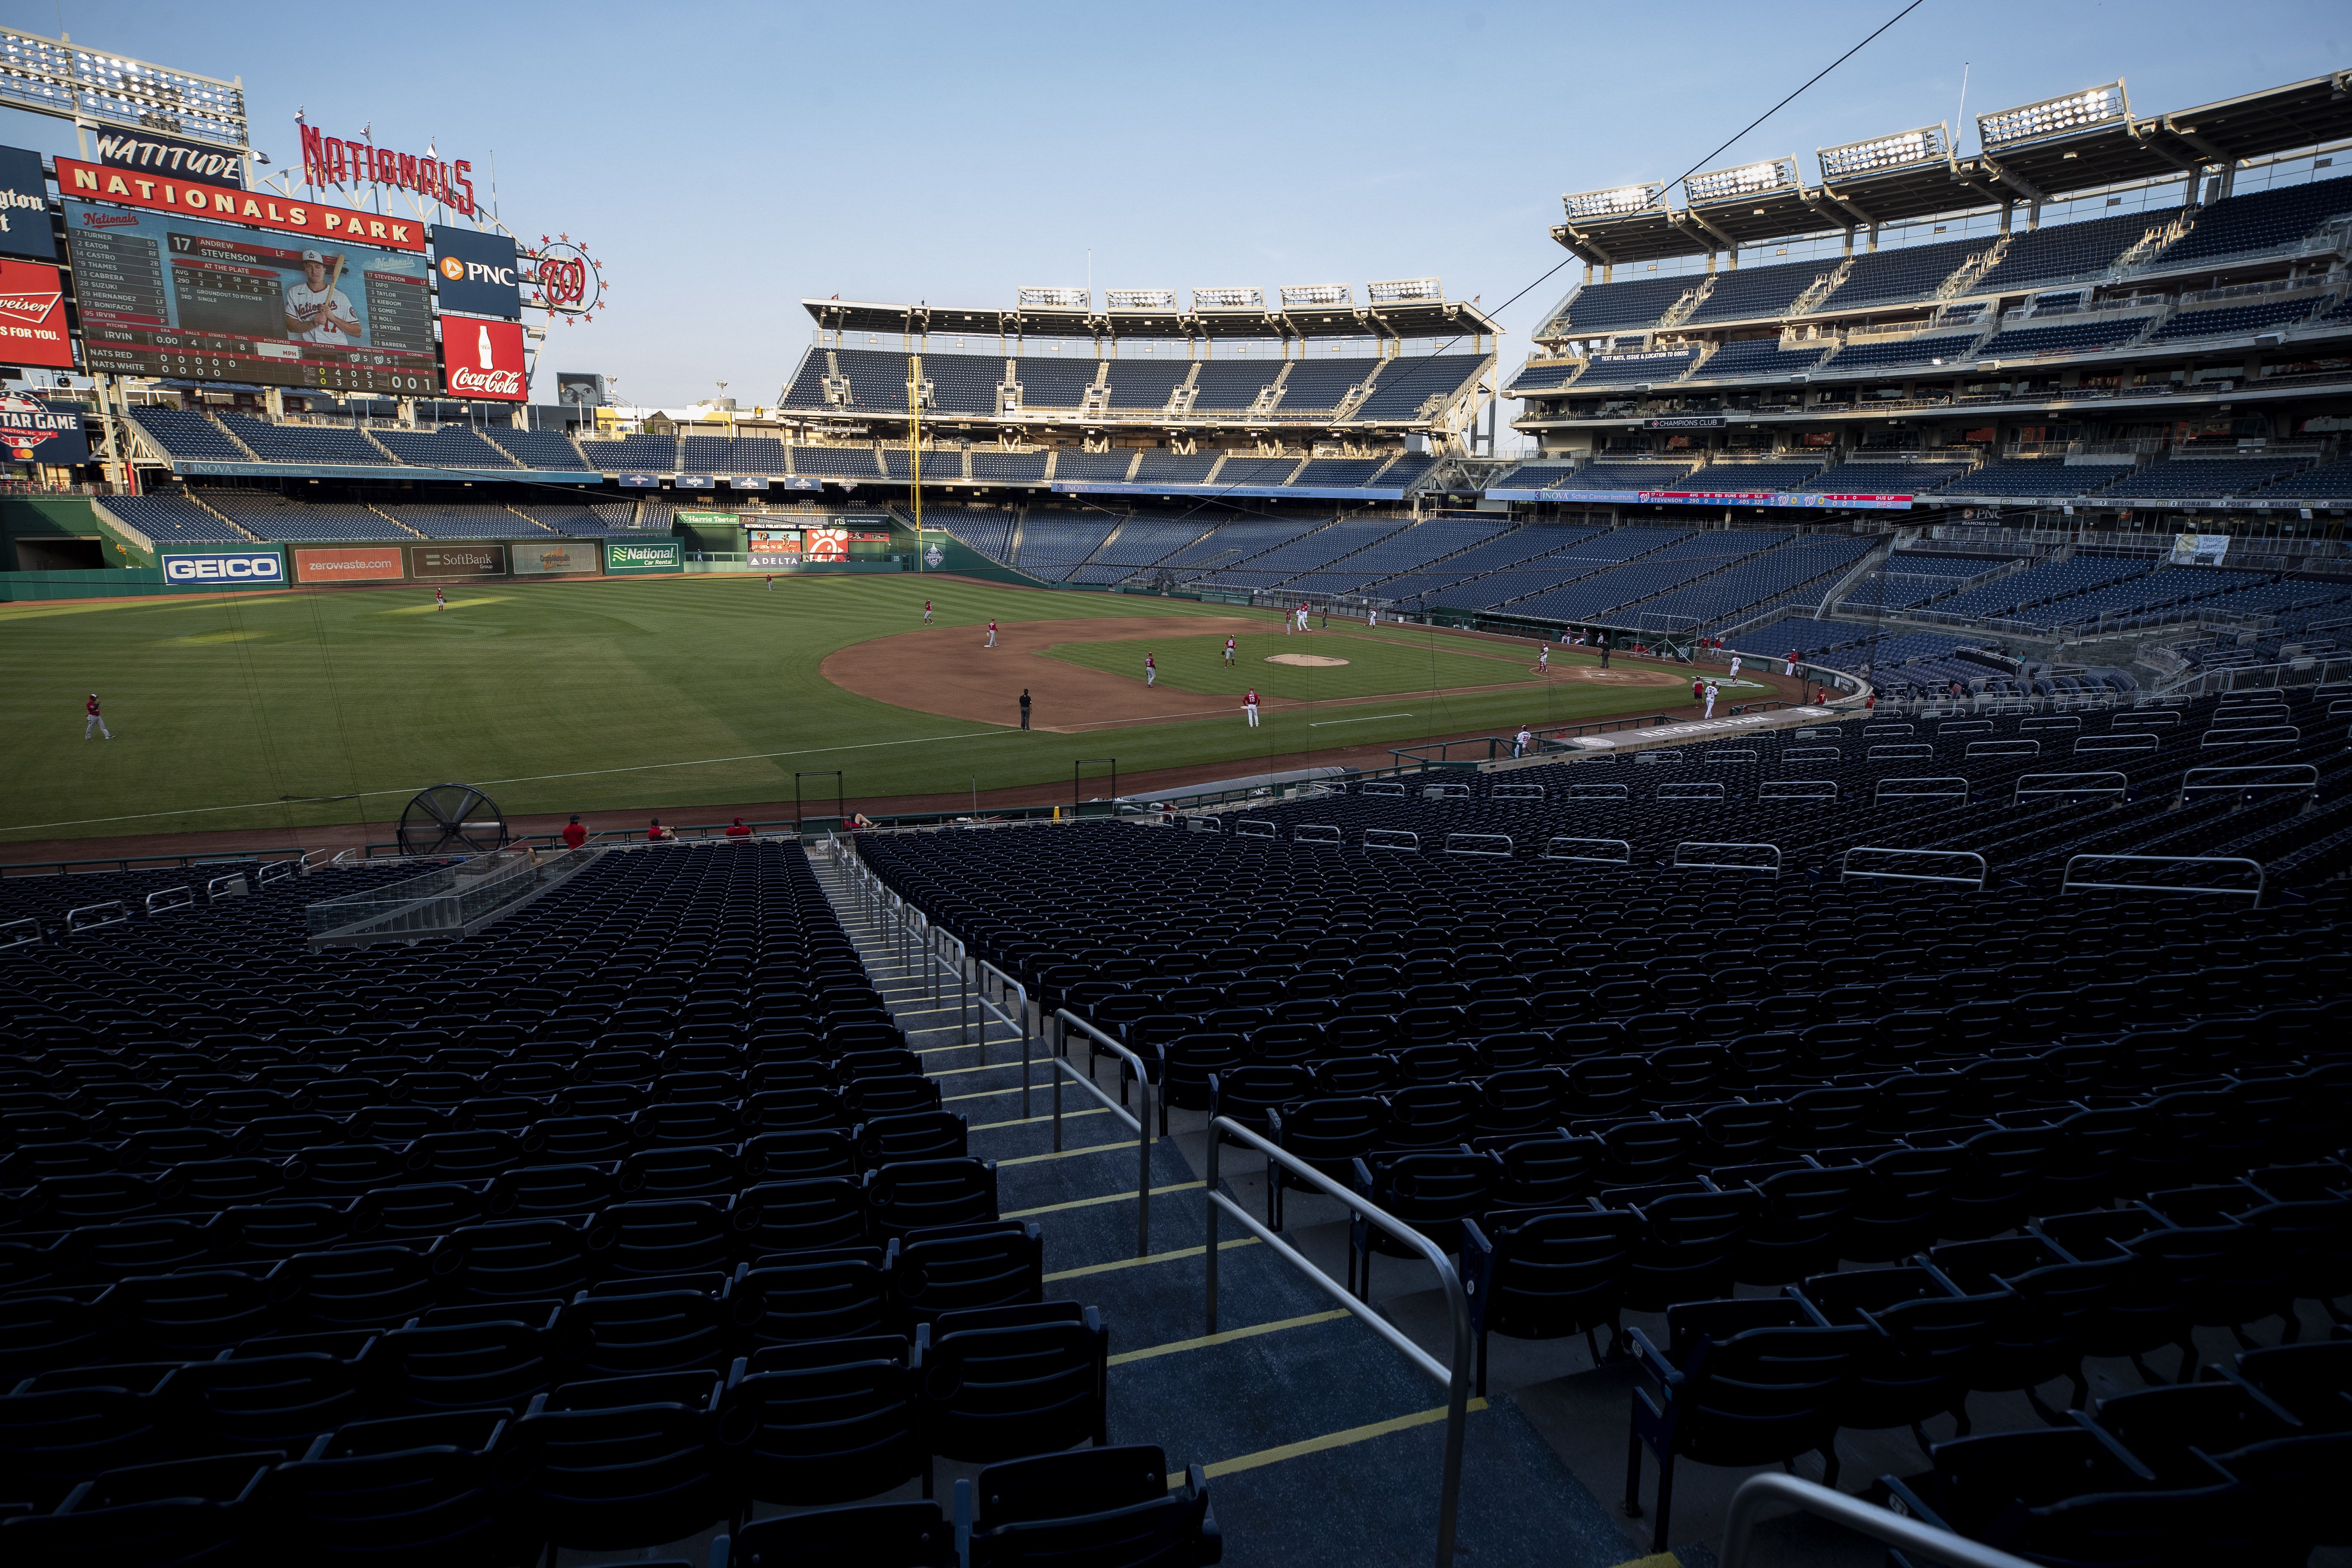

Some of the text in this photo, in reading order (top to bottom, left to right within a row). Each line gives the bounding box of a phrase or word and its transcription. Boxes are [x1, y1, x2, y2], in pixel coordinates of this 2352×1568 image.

[98, 134, 240, 180] NATITUDE
[300, 123, 475, 216] NATIONALS
[74, 168, 410, 243] NATIONALS PARK
[83, 212, 139, 229] Nationals
[83, 231, 113, 241] TURNER
[85, 242, 109, 250] EATON
[173, 237, 191, 251] 17
[200, 239, 233, 249] ANDREW
[87, 251, 116, 260] CASTRO
[201, 248, 257, 263] STEVENSON
[88, 262, 117, 270] THAMES
[229, 266, 249, 274] PLATE
[90, 272, 124, 281] CABRERA
[374, 274, 405, 282] STEVENSON
[466, 261, 516, 287] PNC
[92, 282, 117, 290] SUZUKI
[93, 292, 137, 302] HERNANDEZ
[196, 289, 231, 298] GROUNDOUT
[95, 302, 133, 311] BONIFACIO
[10, 327, 32, 338] FOR
[34, 329, 60, 340] YOU.
[105, 331, 132, 340] IRVIN
[156, 336, 178, 345] 0.00
[90, 349, 132, 359] NATS RED
[92, 360, 145, 371] NATS WHITE
[451, 366, 522, 395] Coca-Cola
[0, 413, 78, 429] TAR GAME
[194, 464, 233, 473] INOVA
[1977, 509, 2003, 519] PNC
[443, 554, 492, 565] SoftBank
[168, 558, 278, 579] GEICO
[309, 560, 392, 571] zerowaste.com
[1840, 677, 1854, 687] NATIONALS
[1634, 716, 1774, 738] NATIONALS PARK
